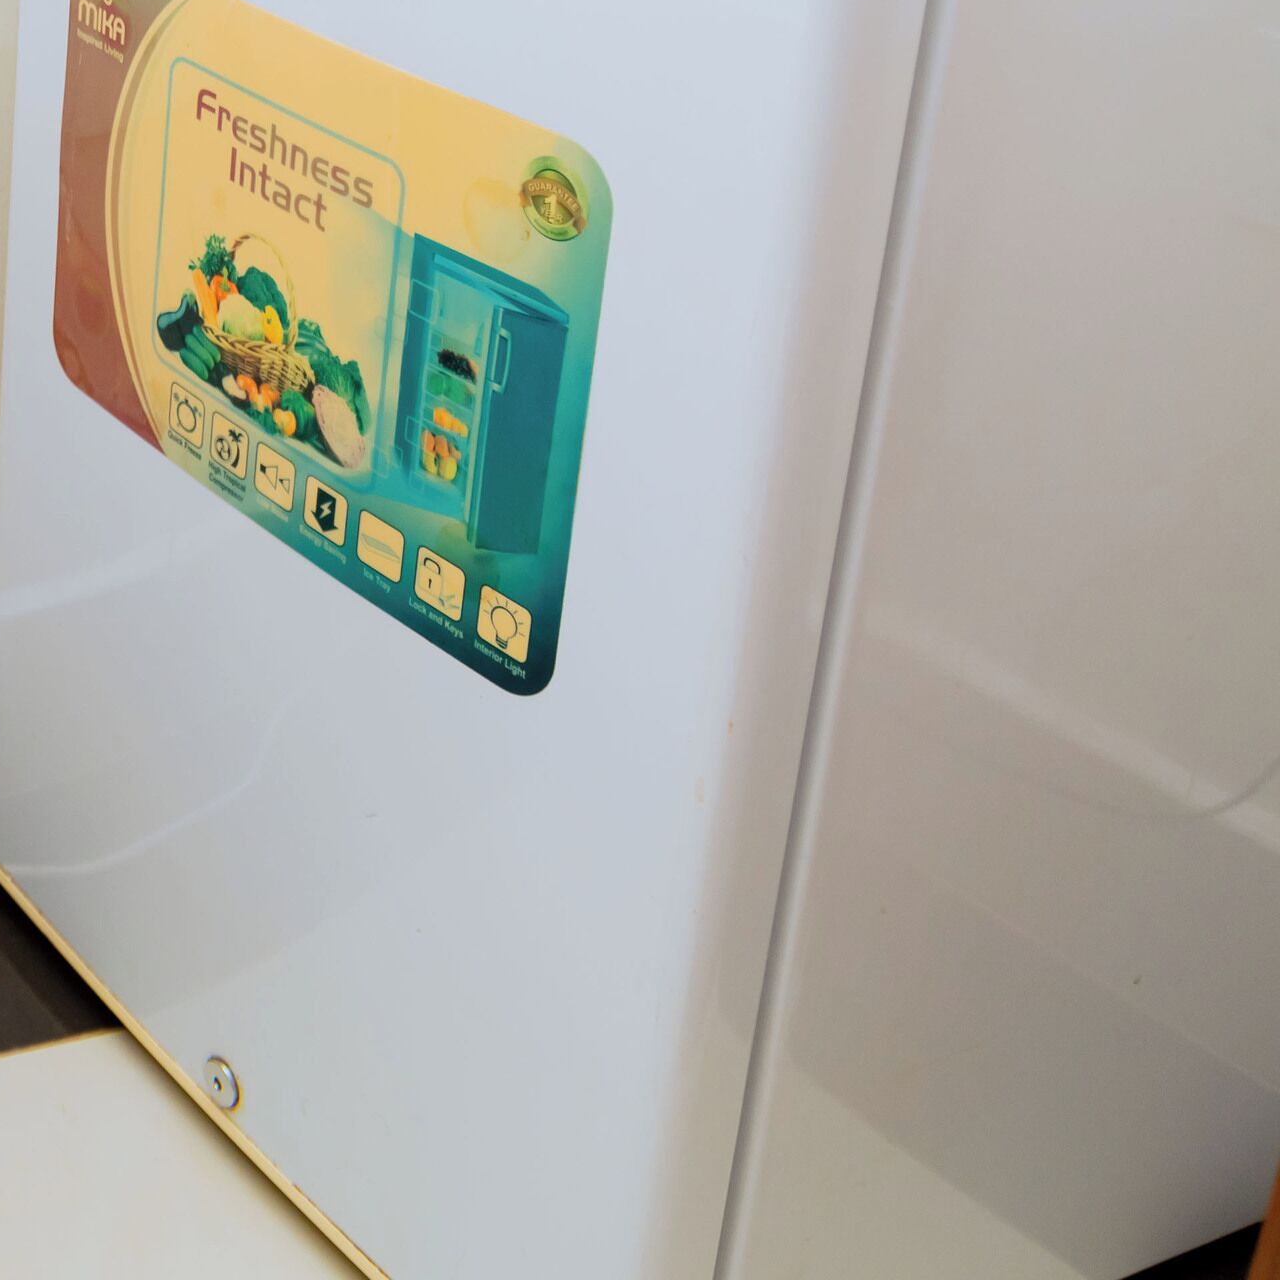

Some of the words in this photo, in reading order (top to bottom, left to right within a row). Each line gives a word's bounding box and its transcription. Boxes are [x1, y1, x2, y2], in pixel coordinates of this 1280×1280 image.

[78, 0, 126, 46] MIKA
[196, 88, 374, 209] Freshness
[229, 146, 328, 233] Intact
[528, 182, 580, 213] GUARANTEE
[208, 460, 223, 476] High
[363, 568, 374, 582] Ice
[375, 574, 390, 594] Tray
[409, 596, 427, 615] Lock
[428, 609, 442, 627] and
[444, 620, 464, 639] Keys
[474, 638, 503, 664] Interior
[505, 658, 526, 680] Light
